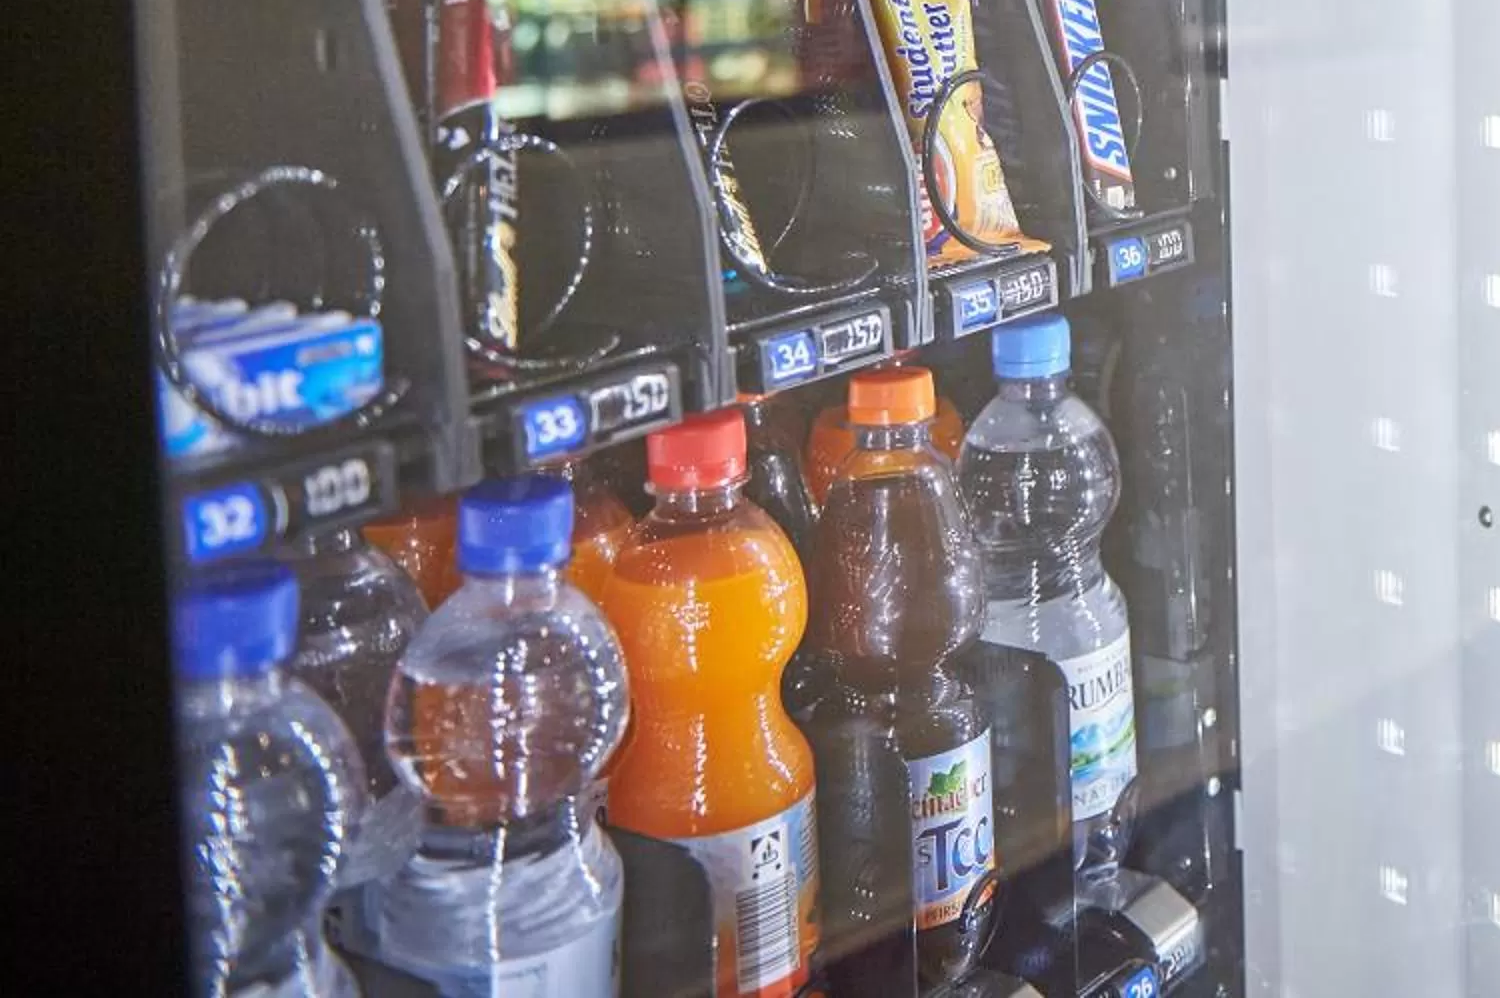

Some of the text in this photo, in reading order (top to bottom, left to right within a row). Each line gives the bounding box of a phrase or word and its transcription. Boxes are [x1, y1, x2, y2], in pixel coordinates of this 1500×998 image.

[1118, 245, 1142, 269] 36
[775, 339, 813, 371] 34
[533, 405, 577, 444] 33
[198, 493, 259, 550] 32
